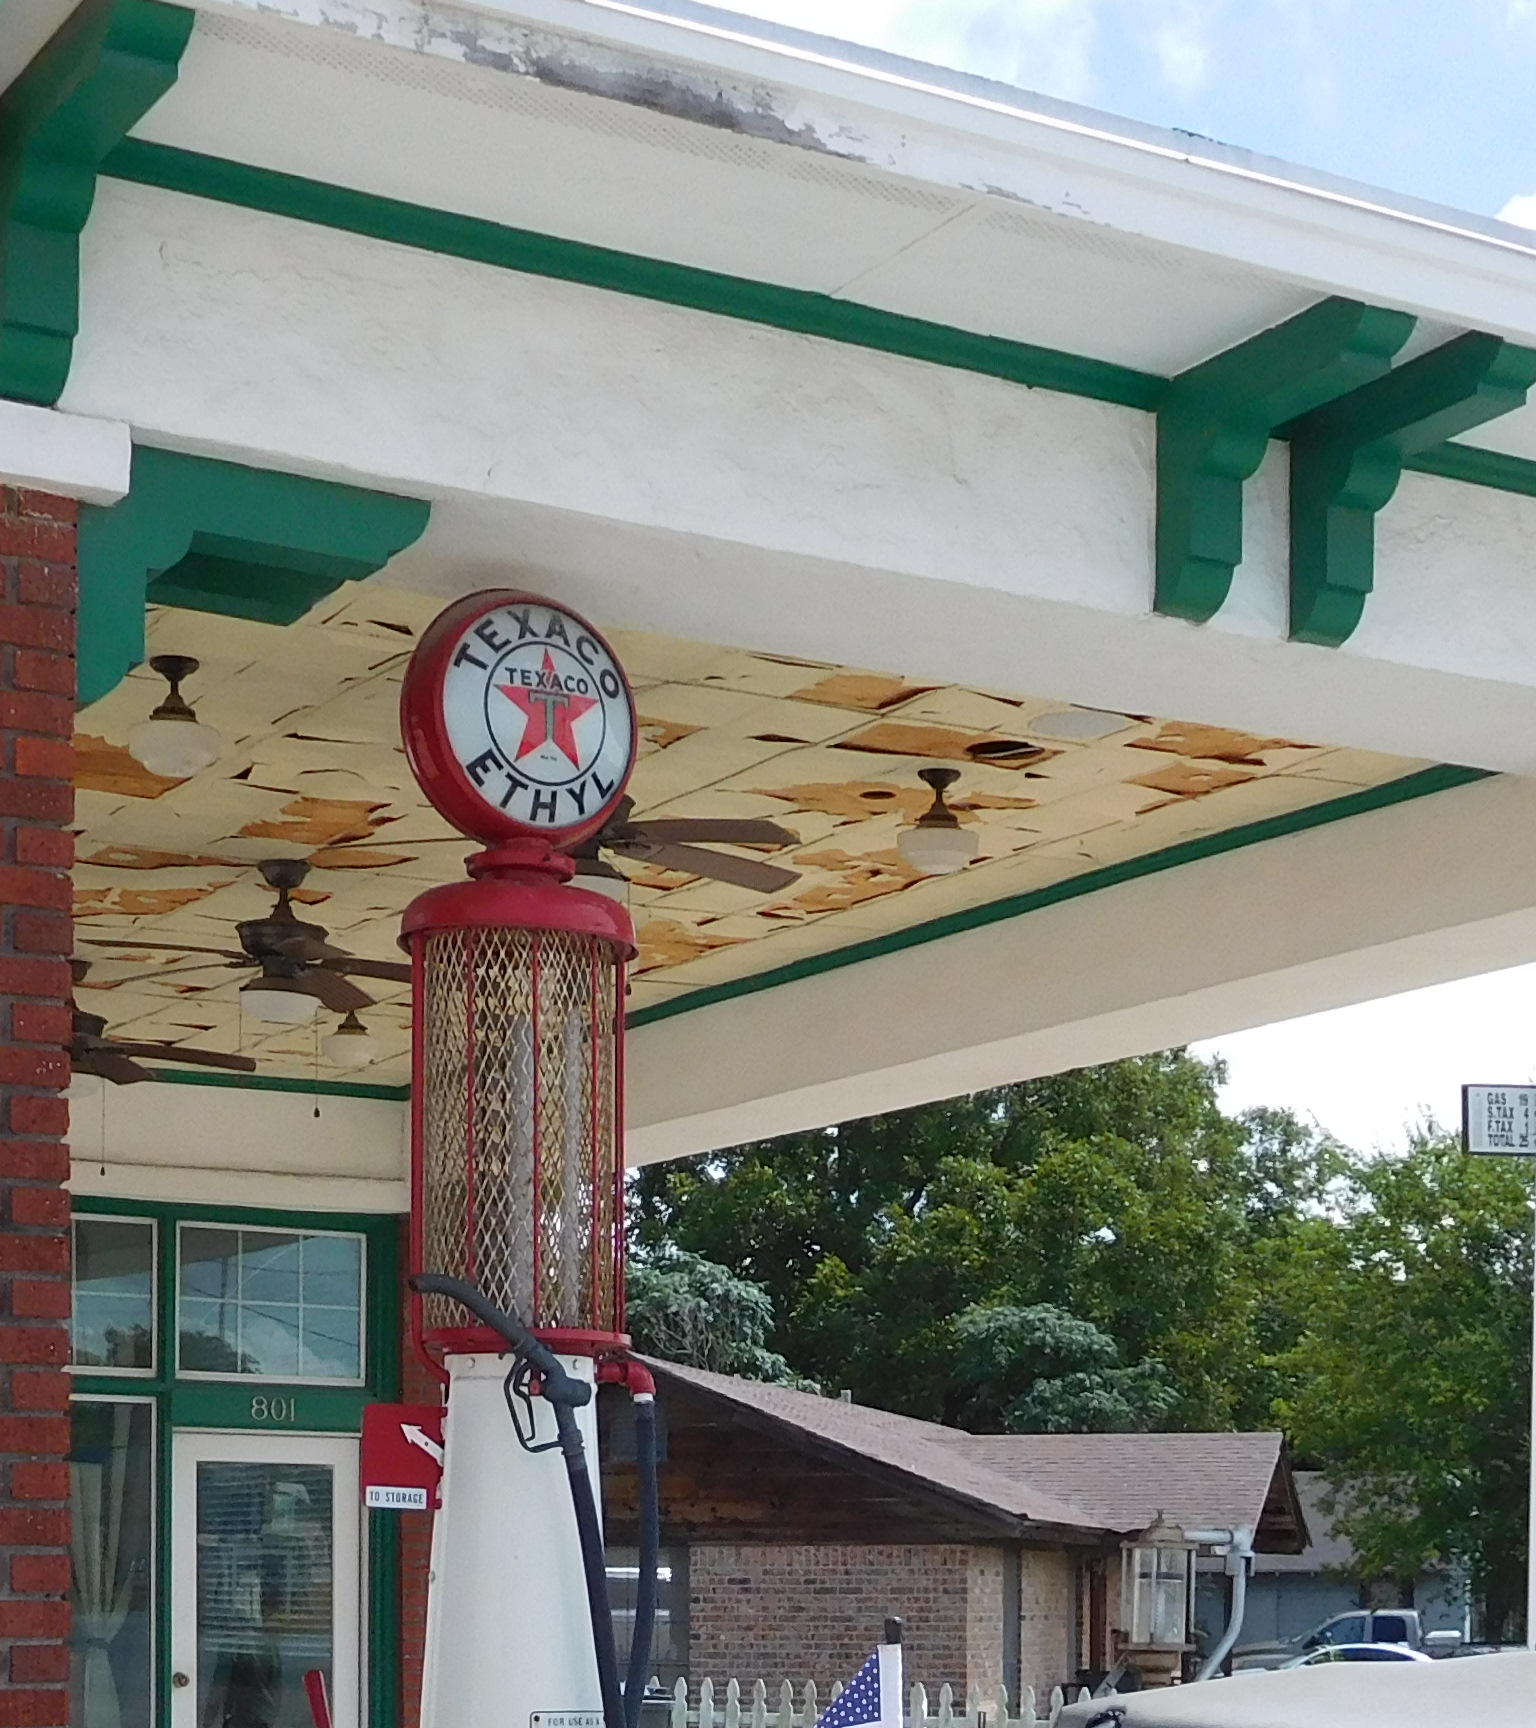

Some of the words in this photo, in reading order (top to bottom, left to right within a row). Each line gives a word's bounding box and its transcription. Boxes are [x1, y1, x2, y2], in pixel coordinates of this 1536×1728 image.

[453, 608, 621, 700] TEXACO
[505, 666, 589, 695] TEXACO
[465, 748, 615, 824] ETHYL
[1487, 1092, 1507, 1106] GAS
[1488, 1133, 1516, 1147] TOTAL
[251, 1396, 295, 1422] 801
[369, 1490, 380, 1502] TO
[385, 1491, 423, 1504] STORAGE
